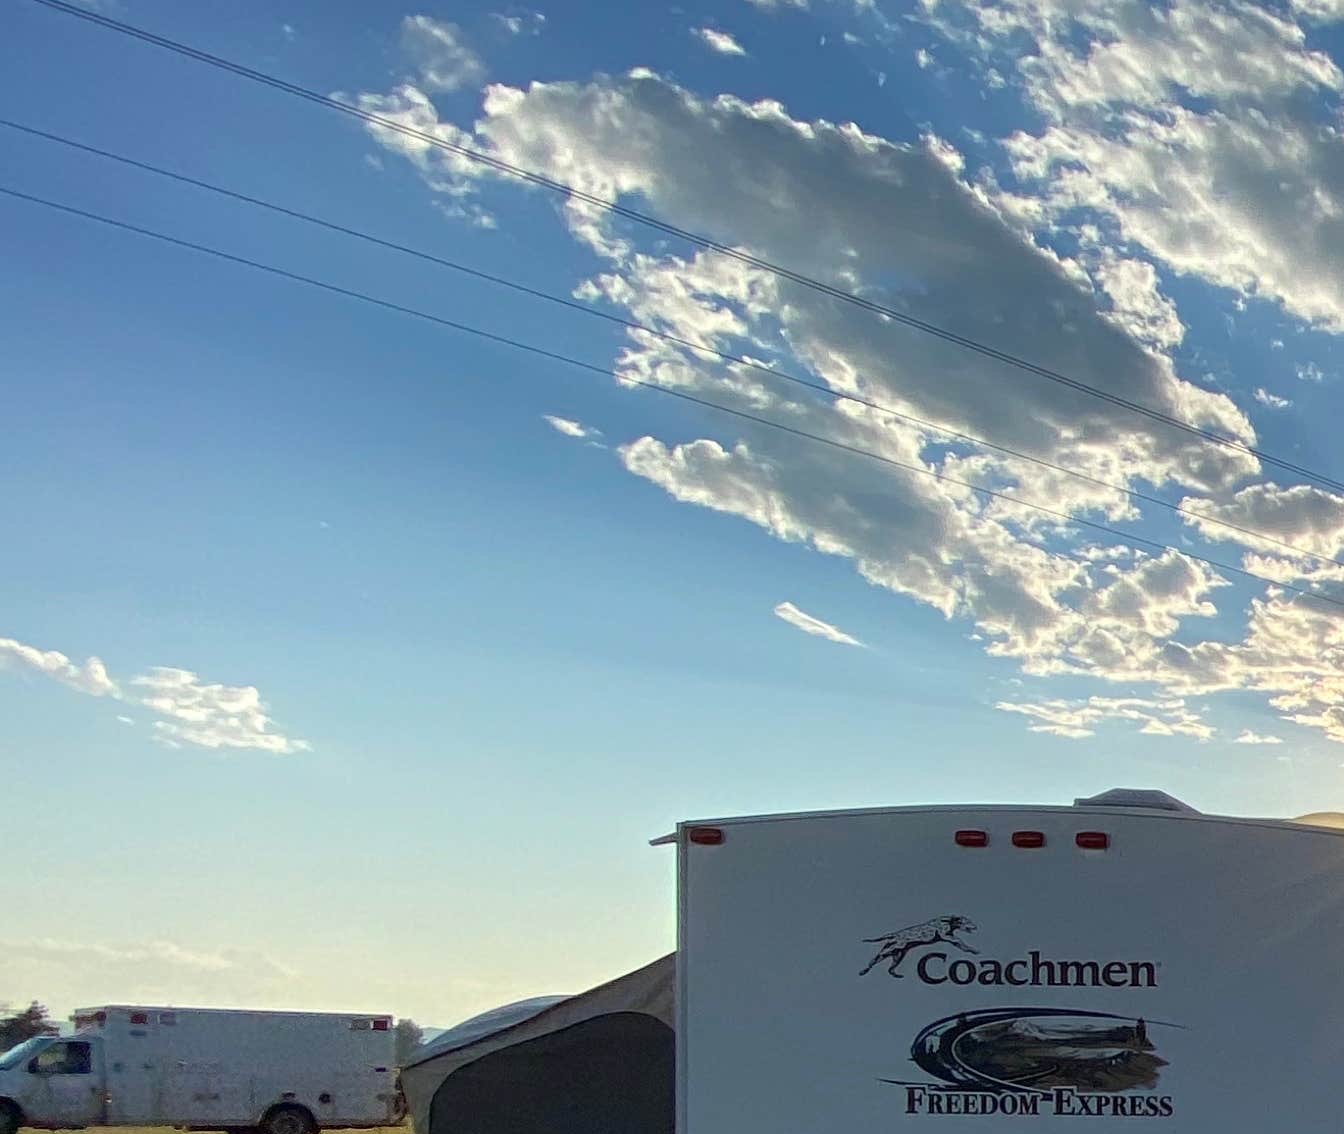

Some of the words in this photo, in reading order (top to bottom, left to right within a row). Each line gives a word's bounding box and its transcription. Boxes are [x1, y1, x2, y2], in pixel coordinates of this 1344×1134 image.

[917, 951, 1158, 988] Coachmen
[905, 1086, 1040, 1115] FREEDOM
[1053, 1086, 1174, 1117] EXPRESS
